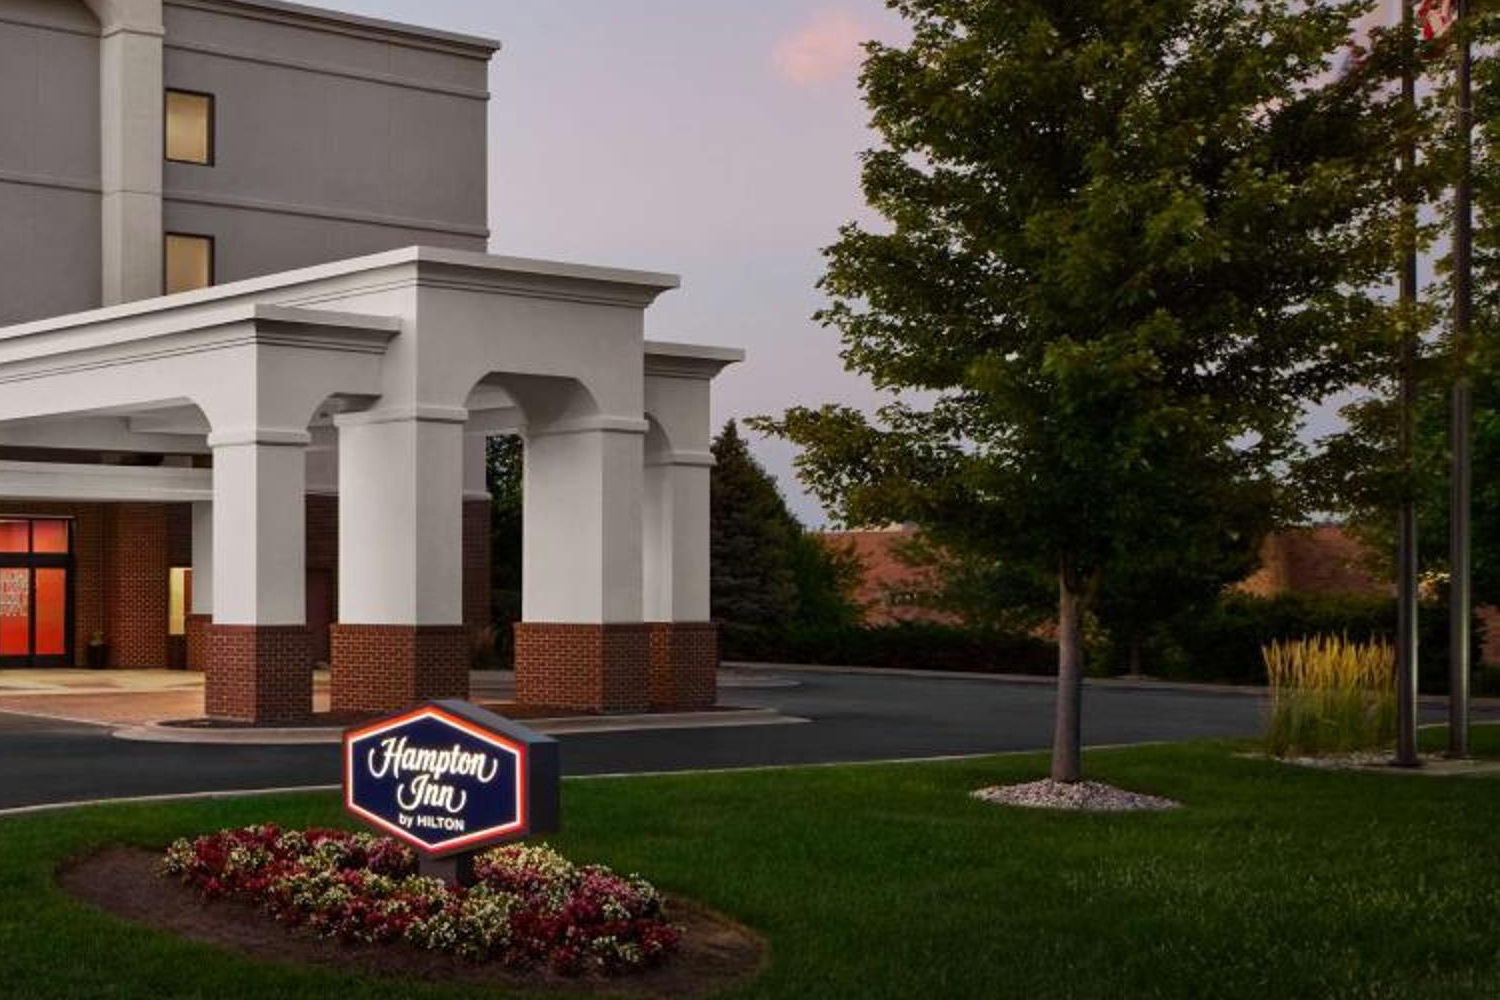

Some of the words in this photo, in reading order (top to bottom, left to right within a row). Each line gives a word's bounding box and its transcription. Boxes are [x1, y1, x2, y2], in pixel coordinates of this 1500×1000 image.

[368, 736, 498, 783] Hampton
[397, 774, 467, 813] Inn
[399, 812, 413, 829] by
[417, 815, 465, 831] HILTON
